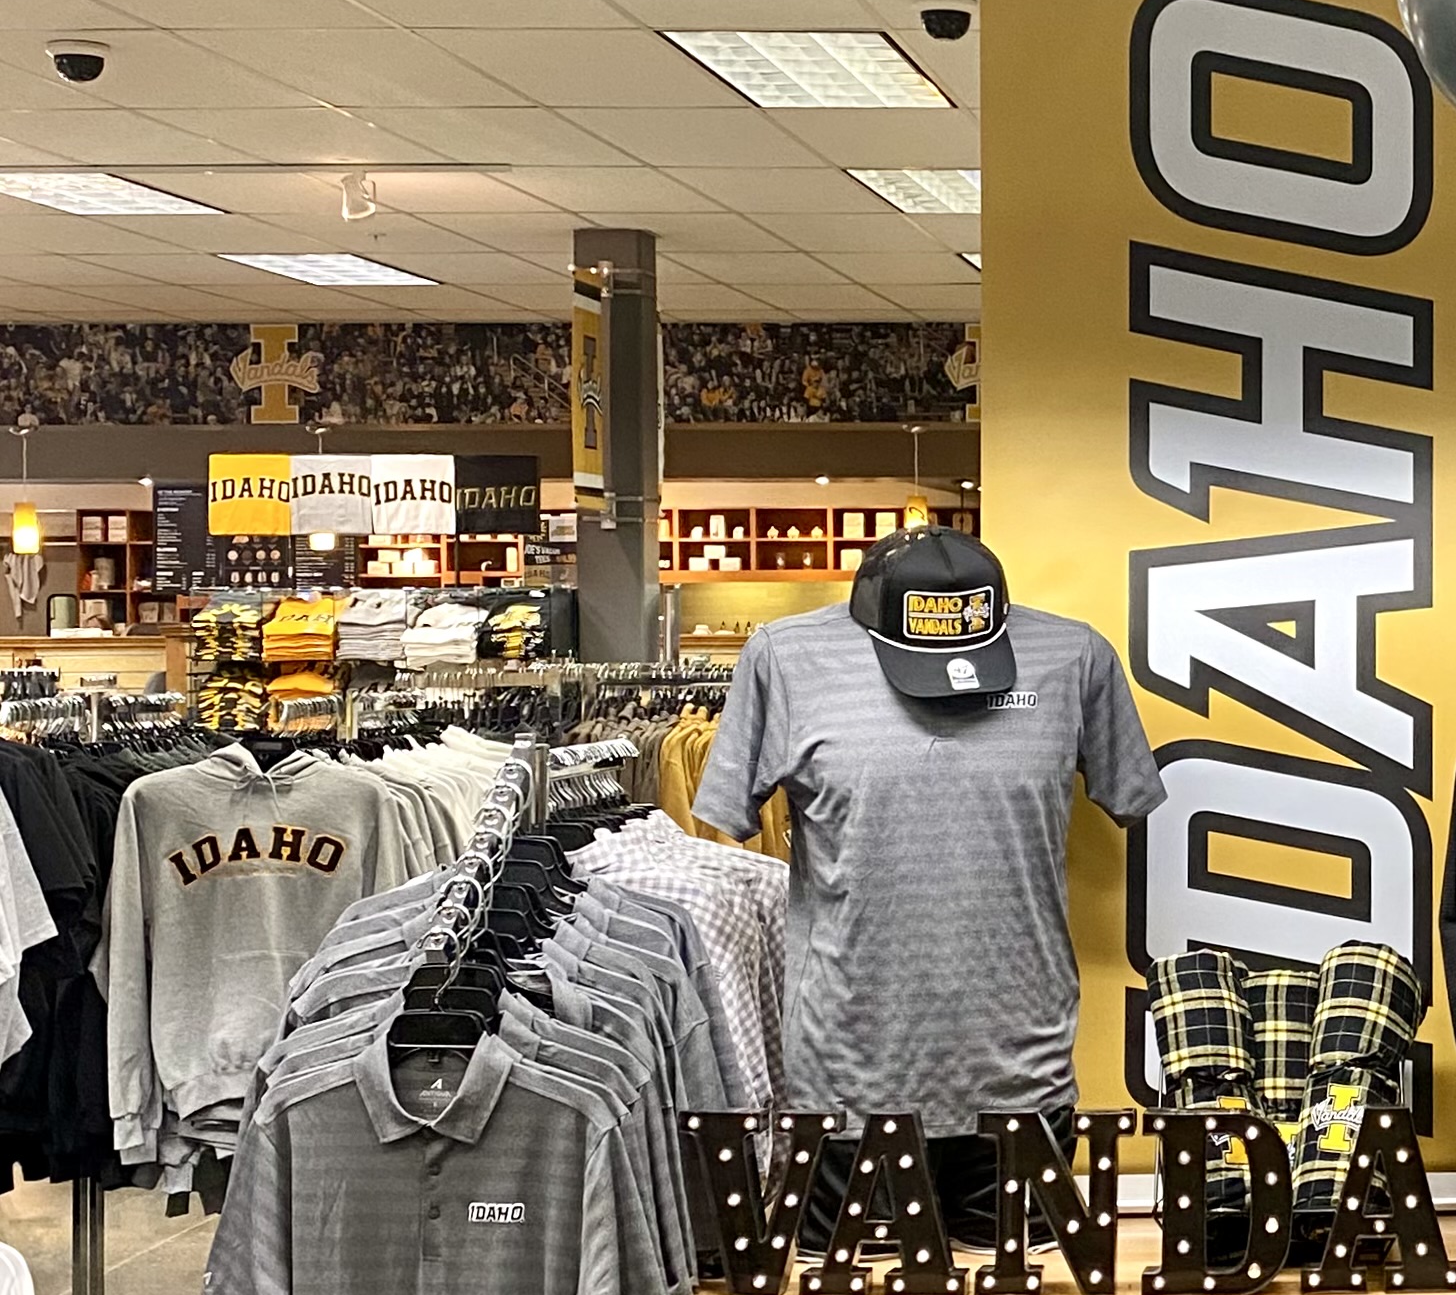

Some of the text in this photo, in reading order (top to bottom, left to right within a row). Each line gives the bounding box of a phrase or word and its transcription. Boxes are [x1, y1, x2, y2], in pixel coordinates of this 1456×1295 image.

[211, 477, 290, 503] IDAHO
[291, 472, 371, 498] IDAHO
[373, 478, 452, 505] IDAHO
[456, 486, 536, 510] IDAHO
[908, 595, 963, 613] IDAHO
[908, 617, 963, 635] VANDALS
[987, 692, 1038, 709] IDAHO
[169, 825, 346, 887] IDAHO
[468, 1203, 525, 1223] IDAHO
